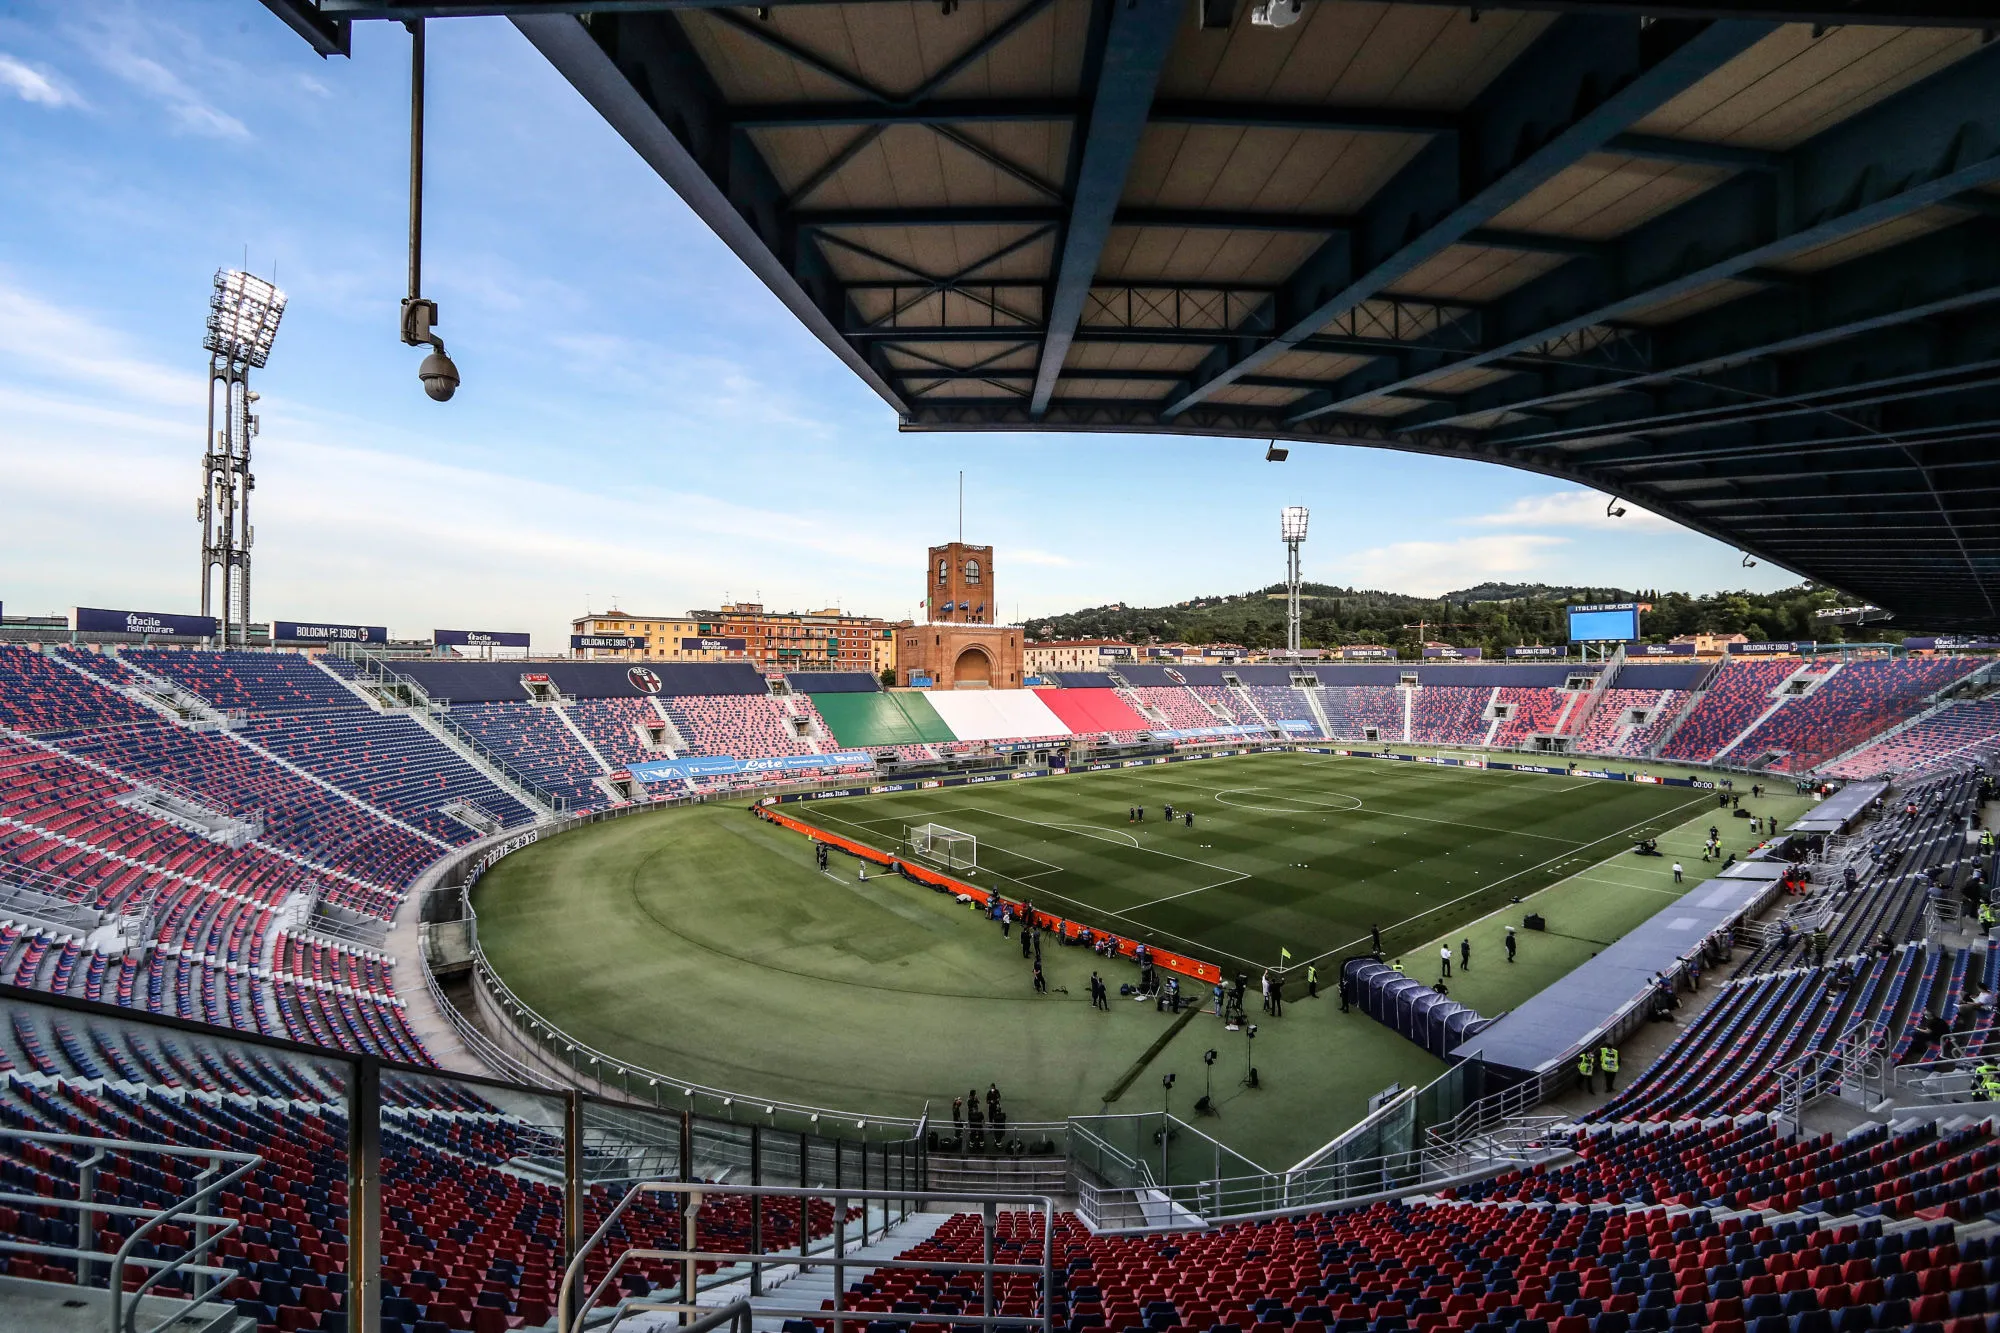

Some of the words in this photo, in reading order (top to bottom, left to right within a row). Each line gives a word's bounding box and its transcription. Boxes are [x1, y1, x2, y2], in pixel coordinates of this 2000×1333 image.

[127, 625, 174, 634] ristrutturare
[296, 626, 328, 638] BOLOGNA
[329, 628, 338, 638] FC
[340, 628, 357, 639] 1909
[581, 637, 605, 646] BOLOGNA
[606, 638, 613, 646] FC
[613, 639, 626, 647] 1909
[741, 760, 783, 771] Lete
[1692, 781, 1712, 789] 00:00
